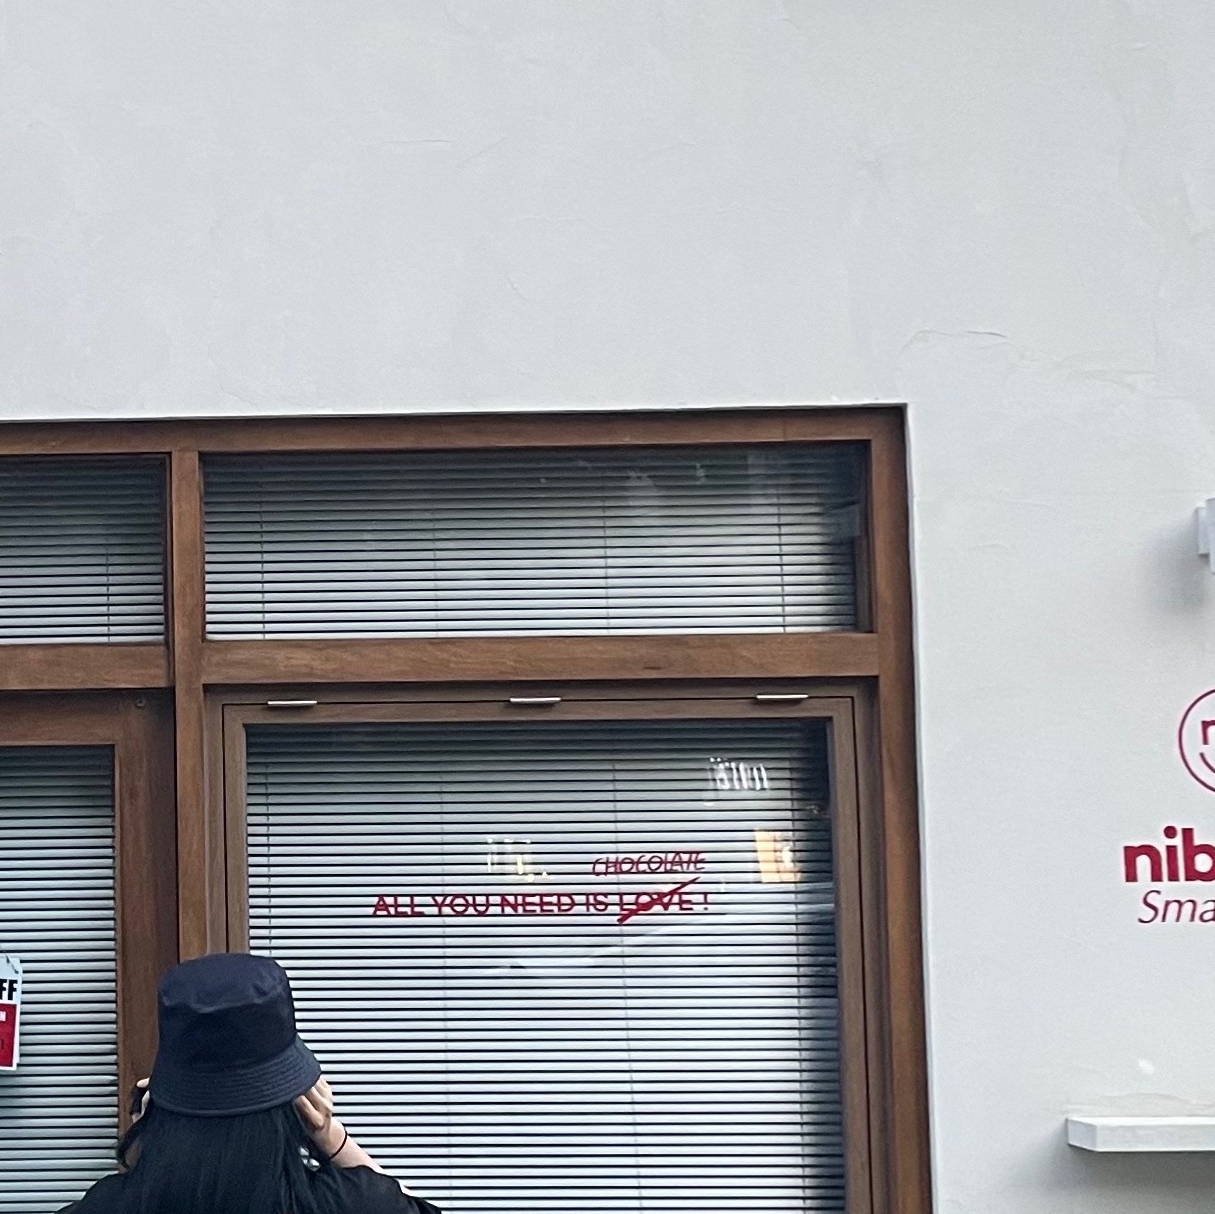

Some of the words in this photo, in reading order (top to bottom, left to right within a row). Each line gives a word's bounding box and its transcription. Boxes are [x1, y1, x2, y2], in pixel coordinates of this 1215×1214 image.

[592, 852, 707, 876] CHOCOLATE
[373, 894, 425, 915] ALL
[432, 894, 490, 915] YOU
[499, 893, 574, 914] NEED
[586, 893, 608, 912] IS
[619, 892, 694, 914] LOVE
